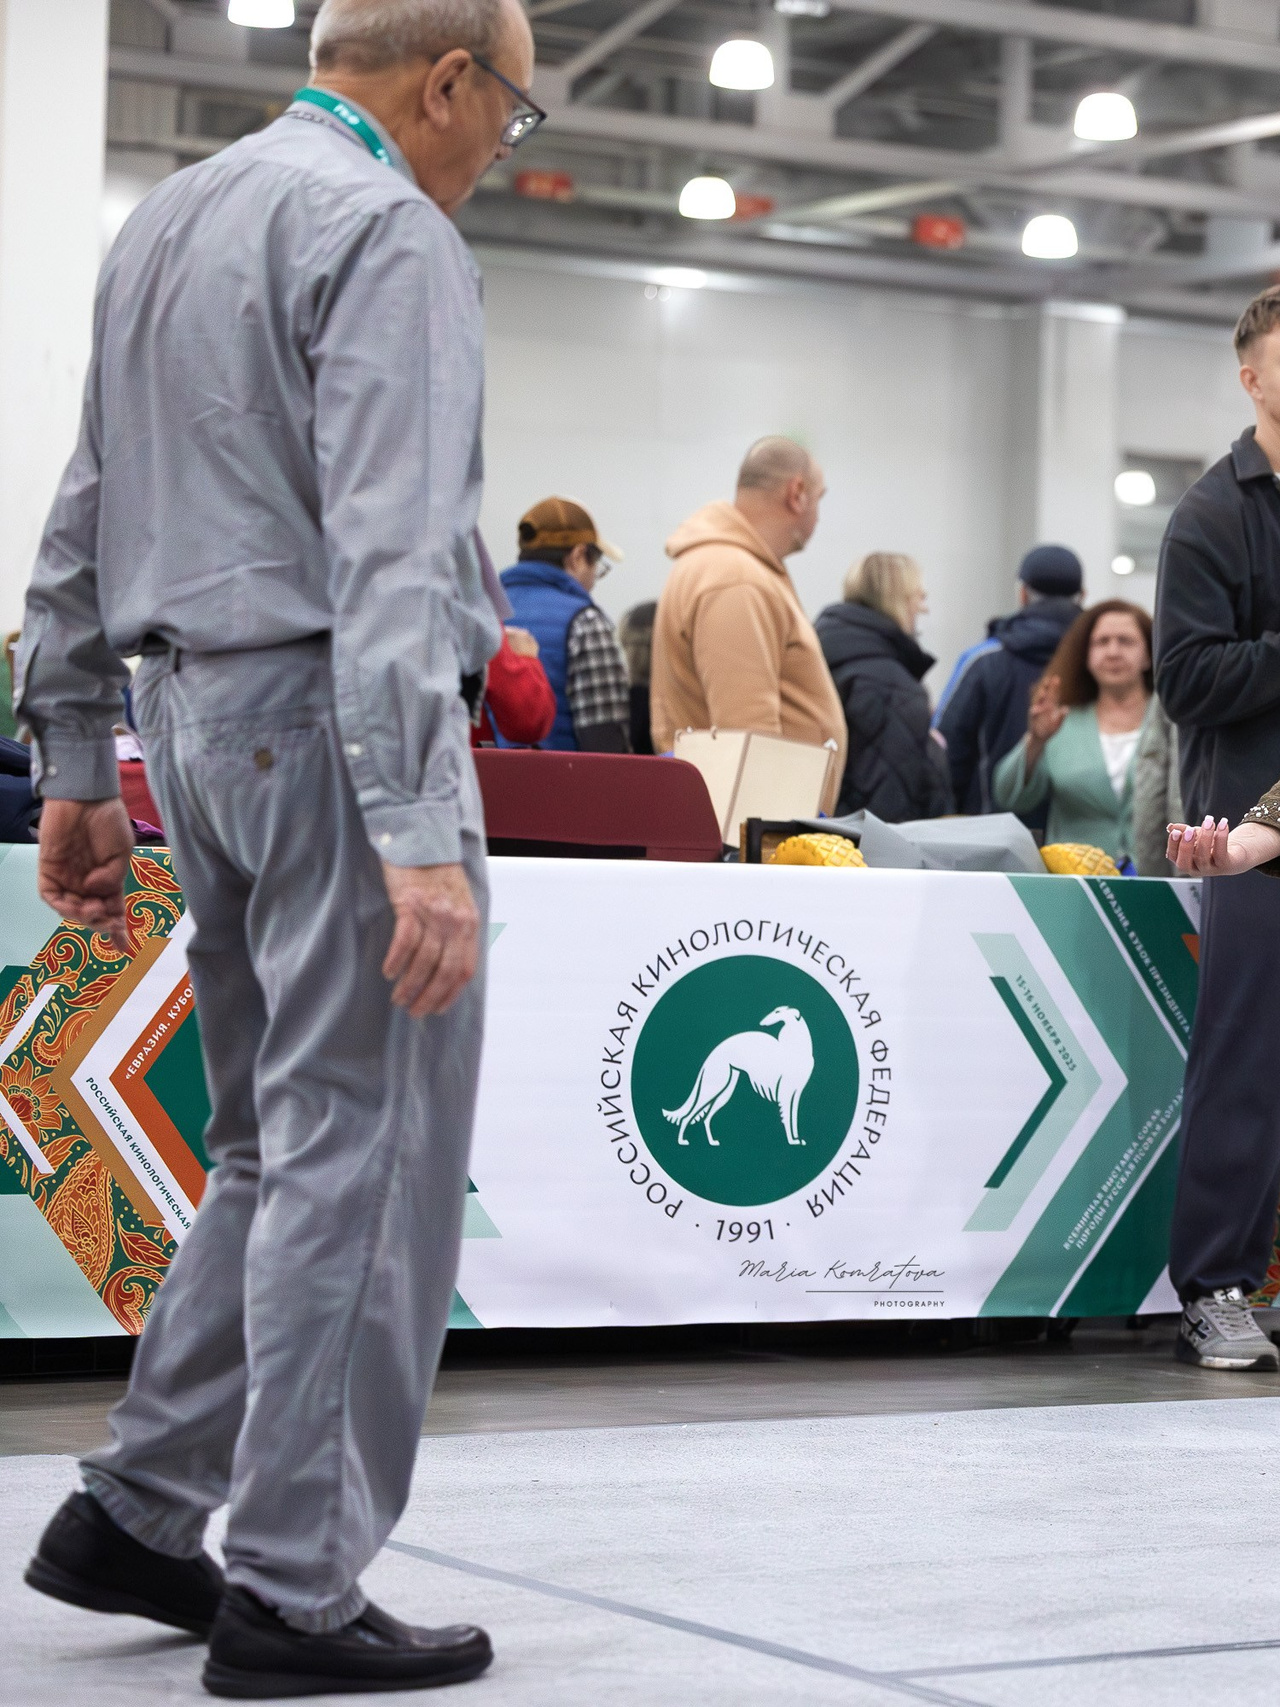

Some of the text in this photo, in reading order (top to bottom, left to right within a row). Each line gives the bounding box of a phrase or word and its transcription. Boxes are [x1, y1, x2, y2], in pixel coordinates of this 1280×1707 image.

[1149, 966, 1190, 1033] ПРЕЗИДЕНТА
[125, 1022, 171, 1080] «ЕВРАЗИЯ.
[597, 919, 892, 1219] РОССИЙСКАЯ КИНОЛОГИЧЕСКАЯ ФЕДЕРАЦИЯ
[1031, 1002, 1061, 1046] НОЯБРЯ
[1058, 1044, 1078, 1072] 2025
[85, 1077, 192, 1230] РОССИЙСКАЯ КИНОЛОГИЧЕСКАЯ
[1103, 1161, 1136, 1208] РУССКАЯ
[1063, 1192, 1104, 1250] ВСЕМИРНАЯ
[1101, 1141, 1139, 1193] ВЫСТАВКА
[716, 1219, 775, 1243] 1991
